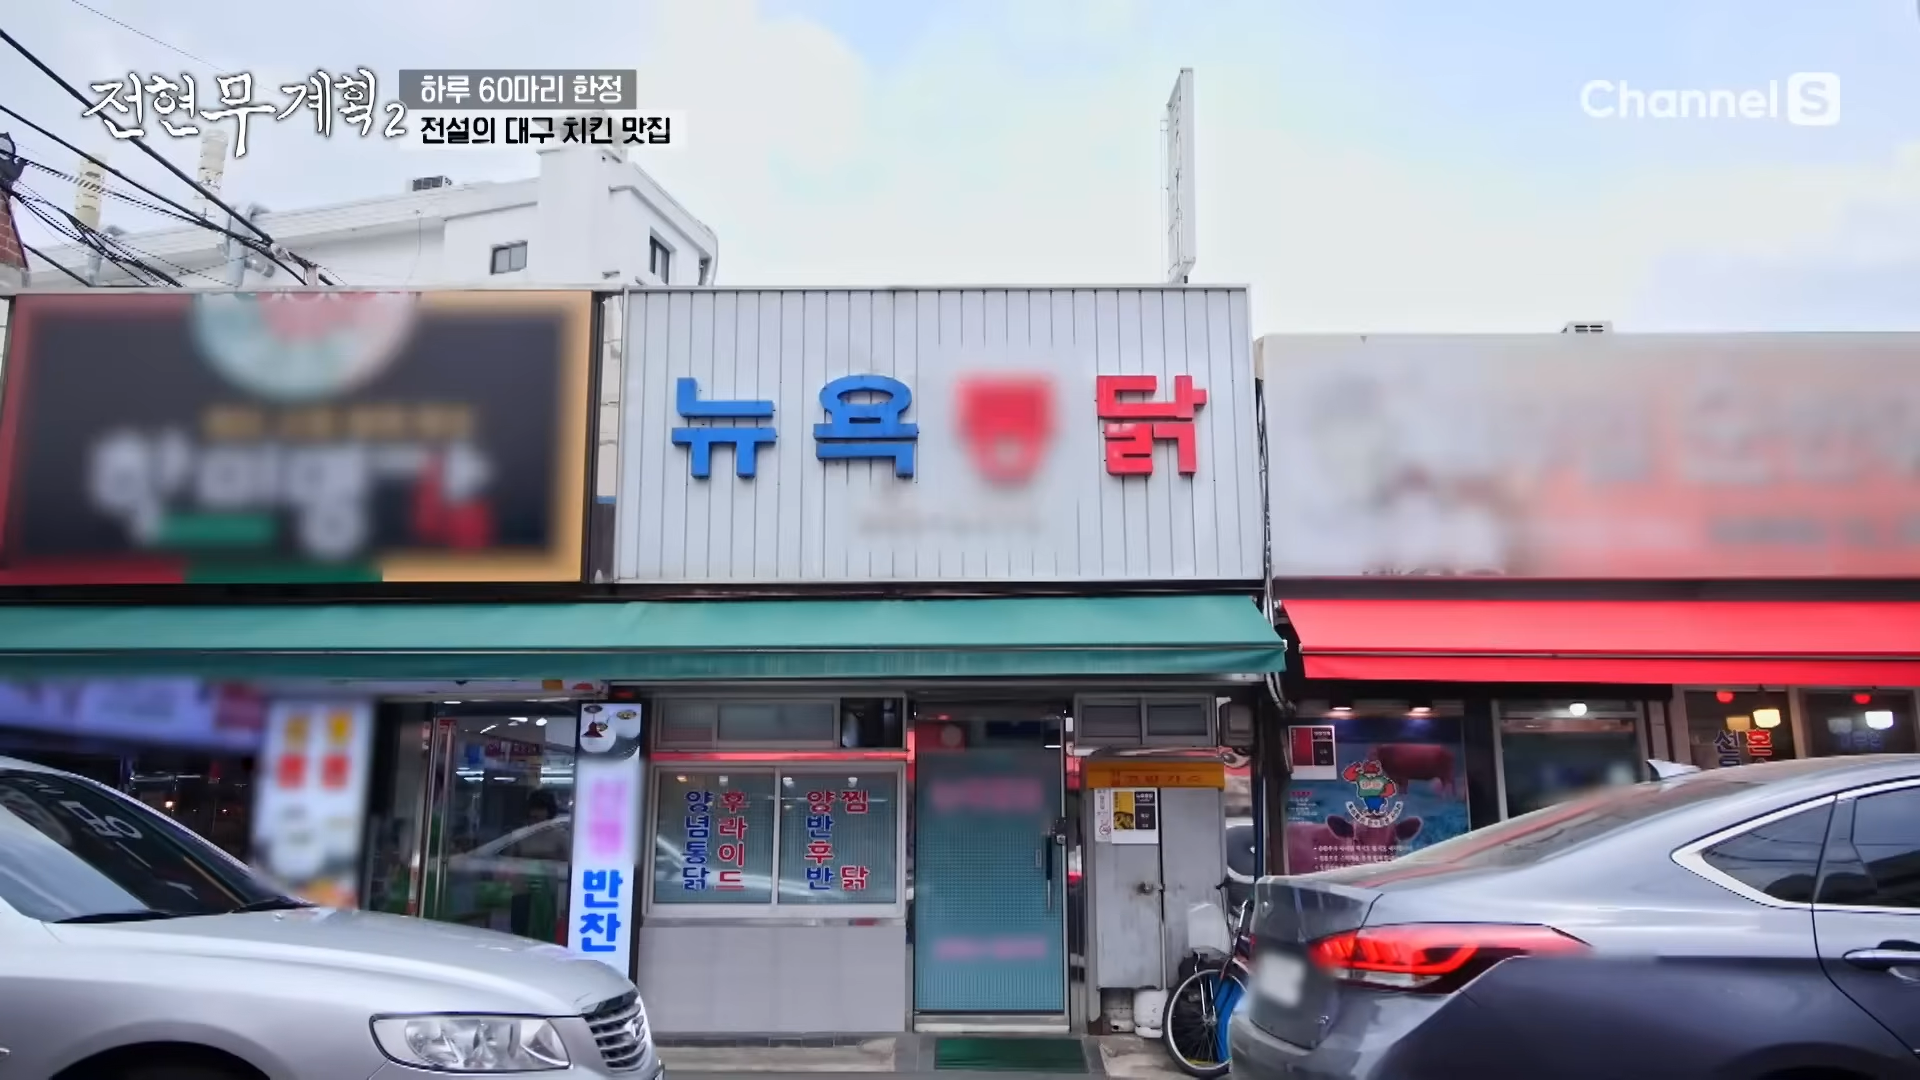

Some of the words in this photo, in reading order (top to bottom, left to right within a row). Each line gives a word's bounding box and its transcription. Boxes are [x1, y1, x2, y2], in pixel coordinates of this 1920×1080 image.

[682, 790, 714, 891] 양념통닭
[714, 789, 749, 892] 후라이드
[804, 790, 837, 891] 양반후반
[579, 869, 623, 953] 반찬
